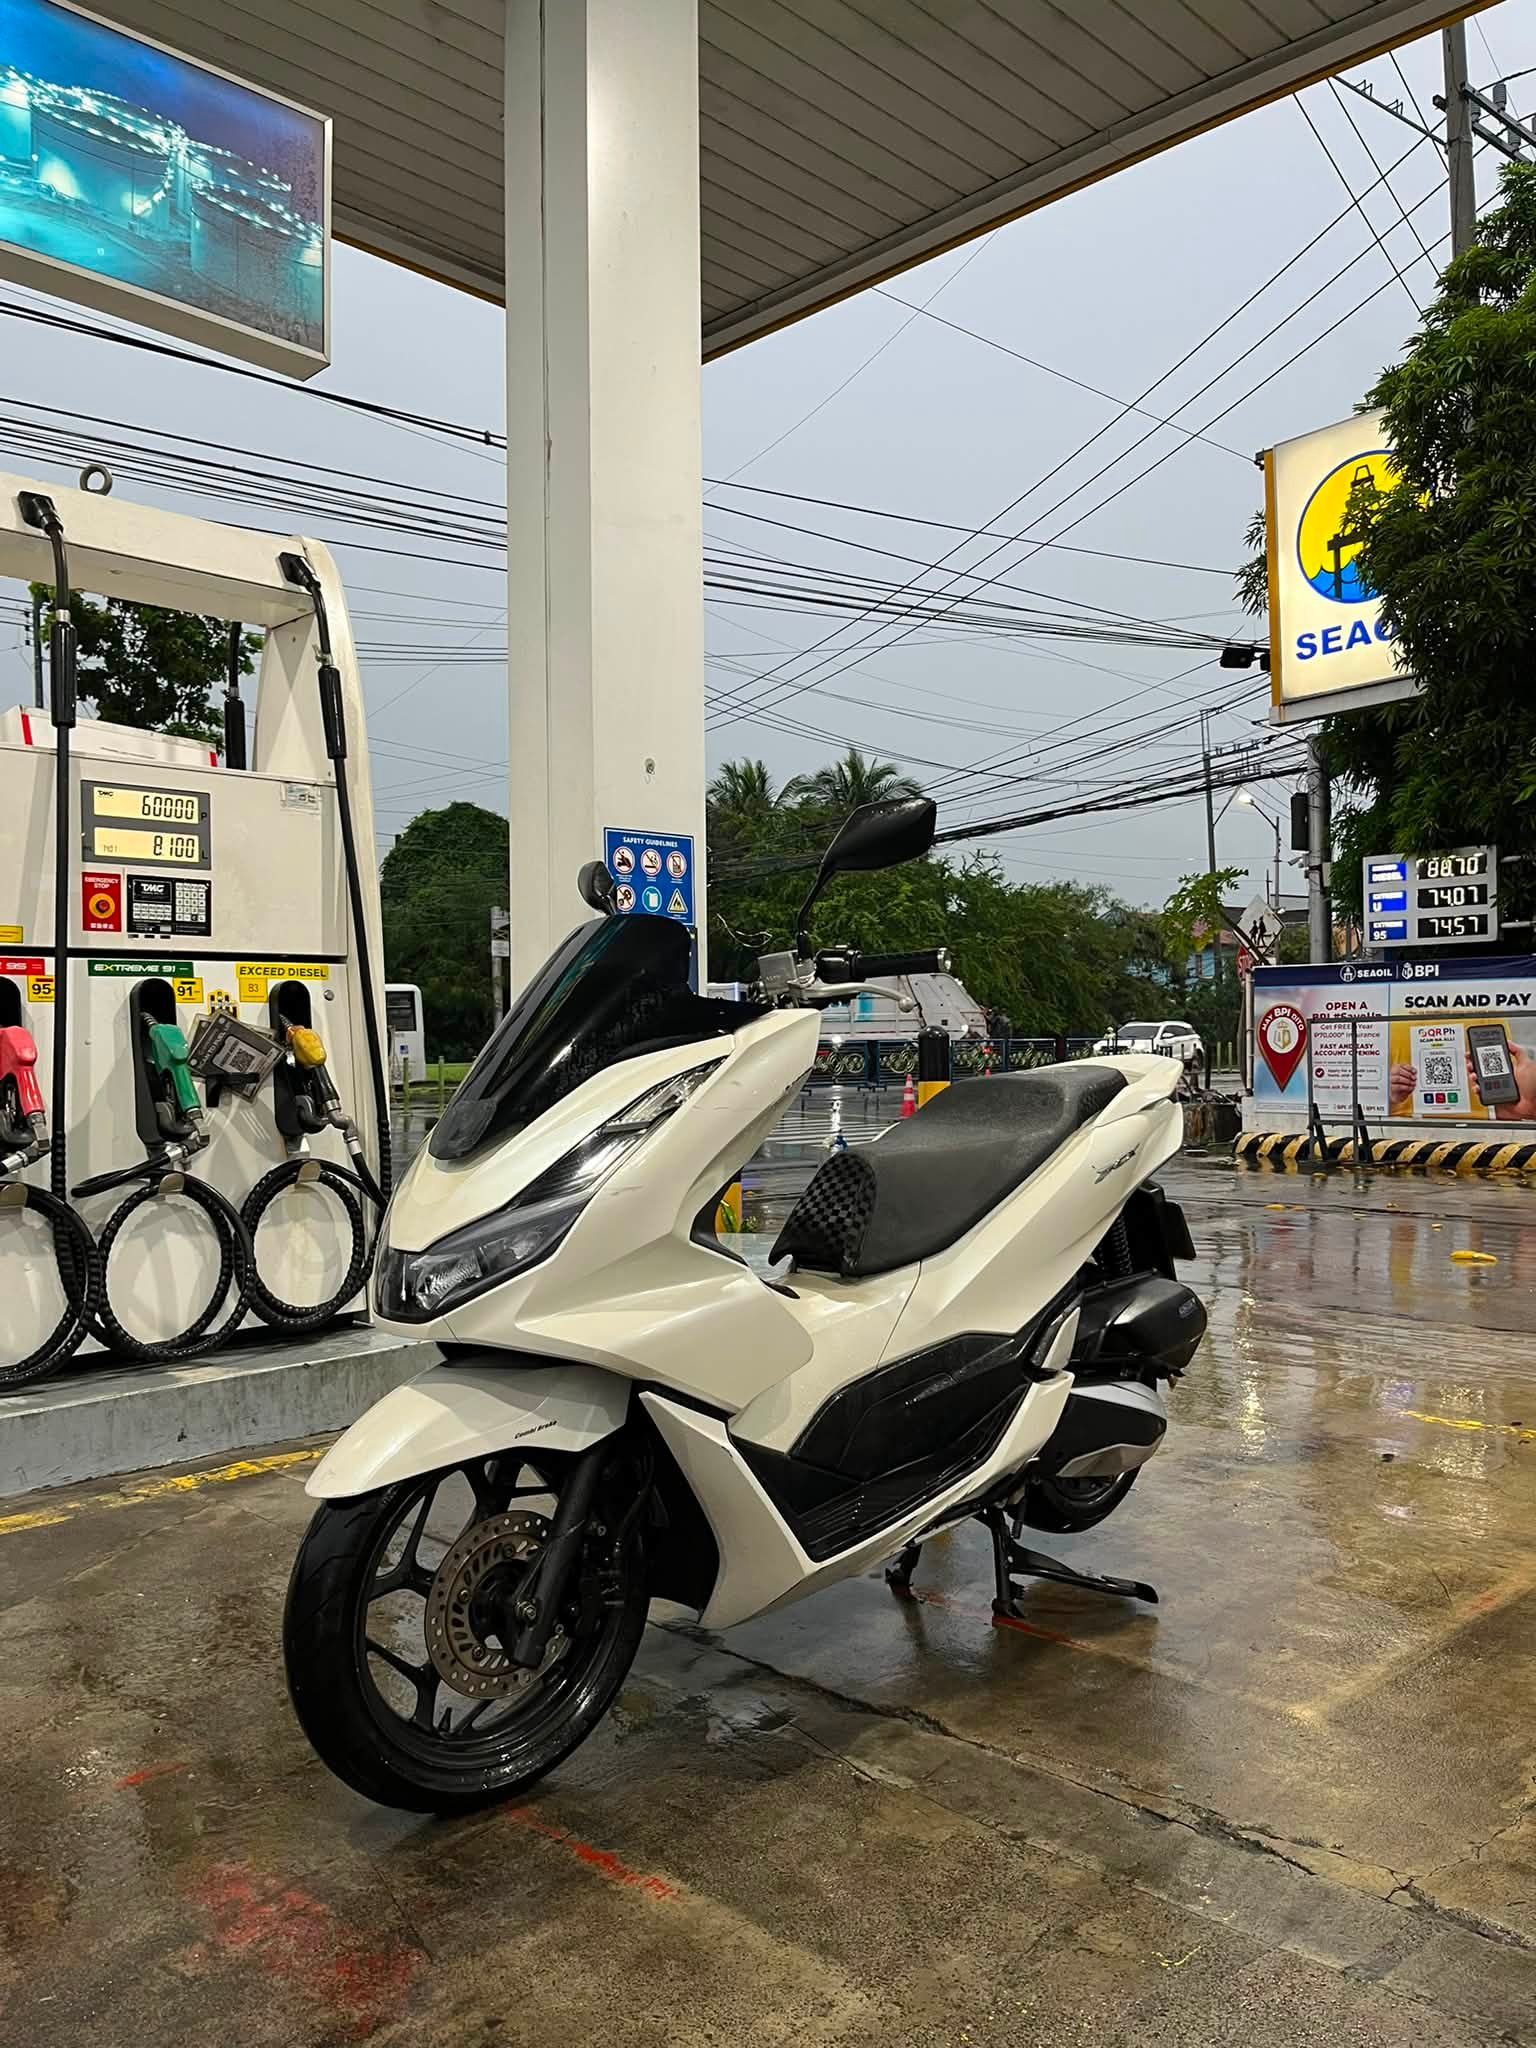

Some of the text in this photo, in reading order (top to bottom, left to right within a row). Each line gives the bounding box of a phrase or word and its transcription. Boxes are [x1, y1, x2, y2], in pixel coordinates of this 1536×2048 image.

[623, 836, 678, 848] SAFETY GUIDELINES
[141, 883, 165, 893] TMG
[1428, 887, 1478, 907] 74.07
[1373, 901, 1382, 912] U
[1429, 916, 1479, 935] 74.57
[1373, 930, 1387, 940] 95
[93, 963, 176, 973] EXTREME 91
[240, 966, 327, 978] EXCEED DIESEL
[1357, 964, 1439, 978] SEAOIL BPI
[32, 984, 52, 995] 95
[177, 985, 193, 997] 91
[1326, 1001, 1368, 1010] OPEN A
[1405, 993, 1532, 1008] SCAN AND PAY
[1261, 1007, 1305, 1031] MAY BPI DITO
[1427, 1027, 1455, 1037] QR Ph
